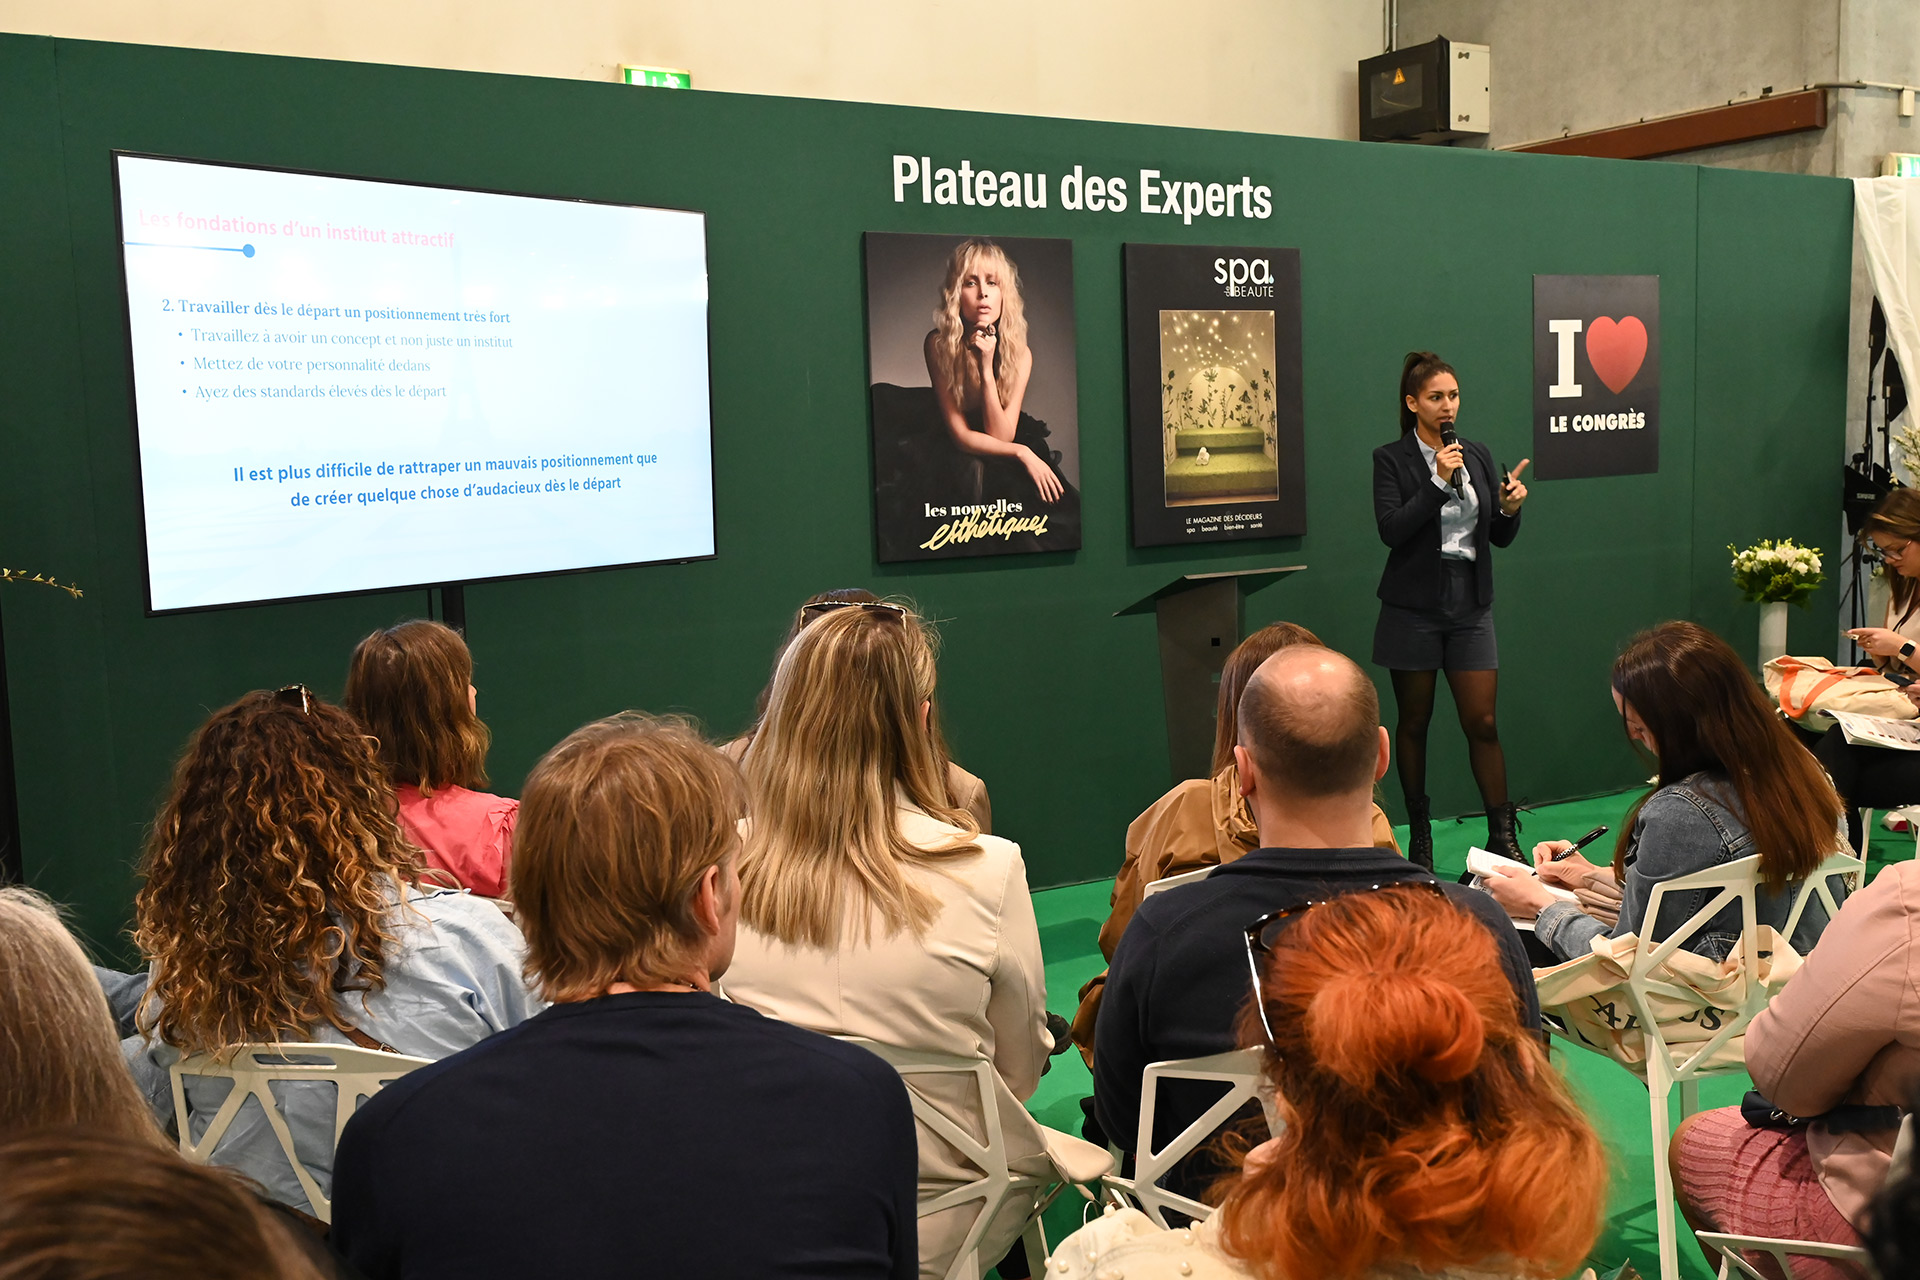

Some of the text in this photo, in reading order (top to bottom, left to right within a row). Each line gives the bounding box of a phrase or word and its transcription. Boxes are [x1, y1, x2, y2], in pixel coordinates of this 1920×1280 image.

[892, 154, 1273, 226] Plateau des Experts
[139, 208, 455, 248] Les fondations d'un institut attractif
[1213, 257, 1269, 297] spa
[1234, 285, 1274, 298] BEAUTE
[162, 299, 511, 323] 2. Travailler dès le départ un positionnement très fort
[191, 328, 513, 350] Travaillez à avoir un concept et non juste un institut
[193, 357, 431, 375] Mettez de votre personnalité dedans
[1548, 319, 1583, 399] I
[195, 384, 447, 403] Ayez des standards élevés dès le départ
[1549, 407, 1646, 434] LE CONGRÈS
[234, 453, 658, 483] Il est plus difficile de rattraper un mauvais positionnement que
[290, 476, 621, 507] de créer quelque chose d'audacieux dès le départ
[924, 498, 1023, 518] les nouvelles
[1185, 512, 1263, 525] LE MAGAZINE DES DÉCIDEURS
[1186, 527, 1196, 535] spa
[1201, 525, 1219, 533] beauté
[1250, 521, 1263, 529] santé
